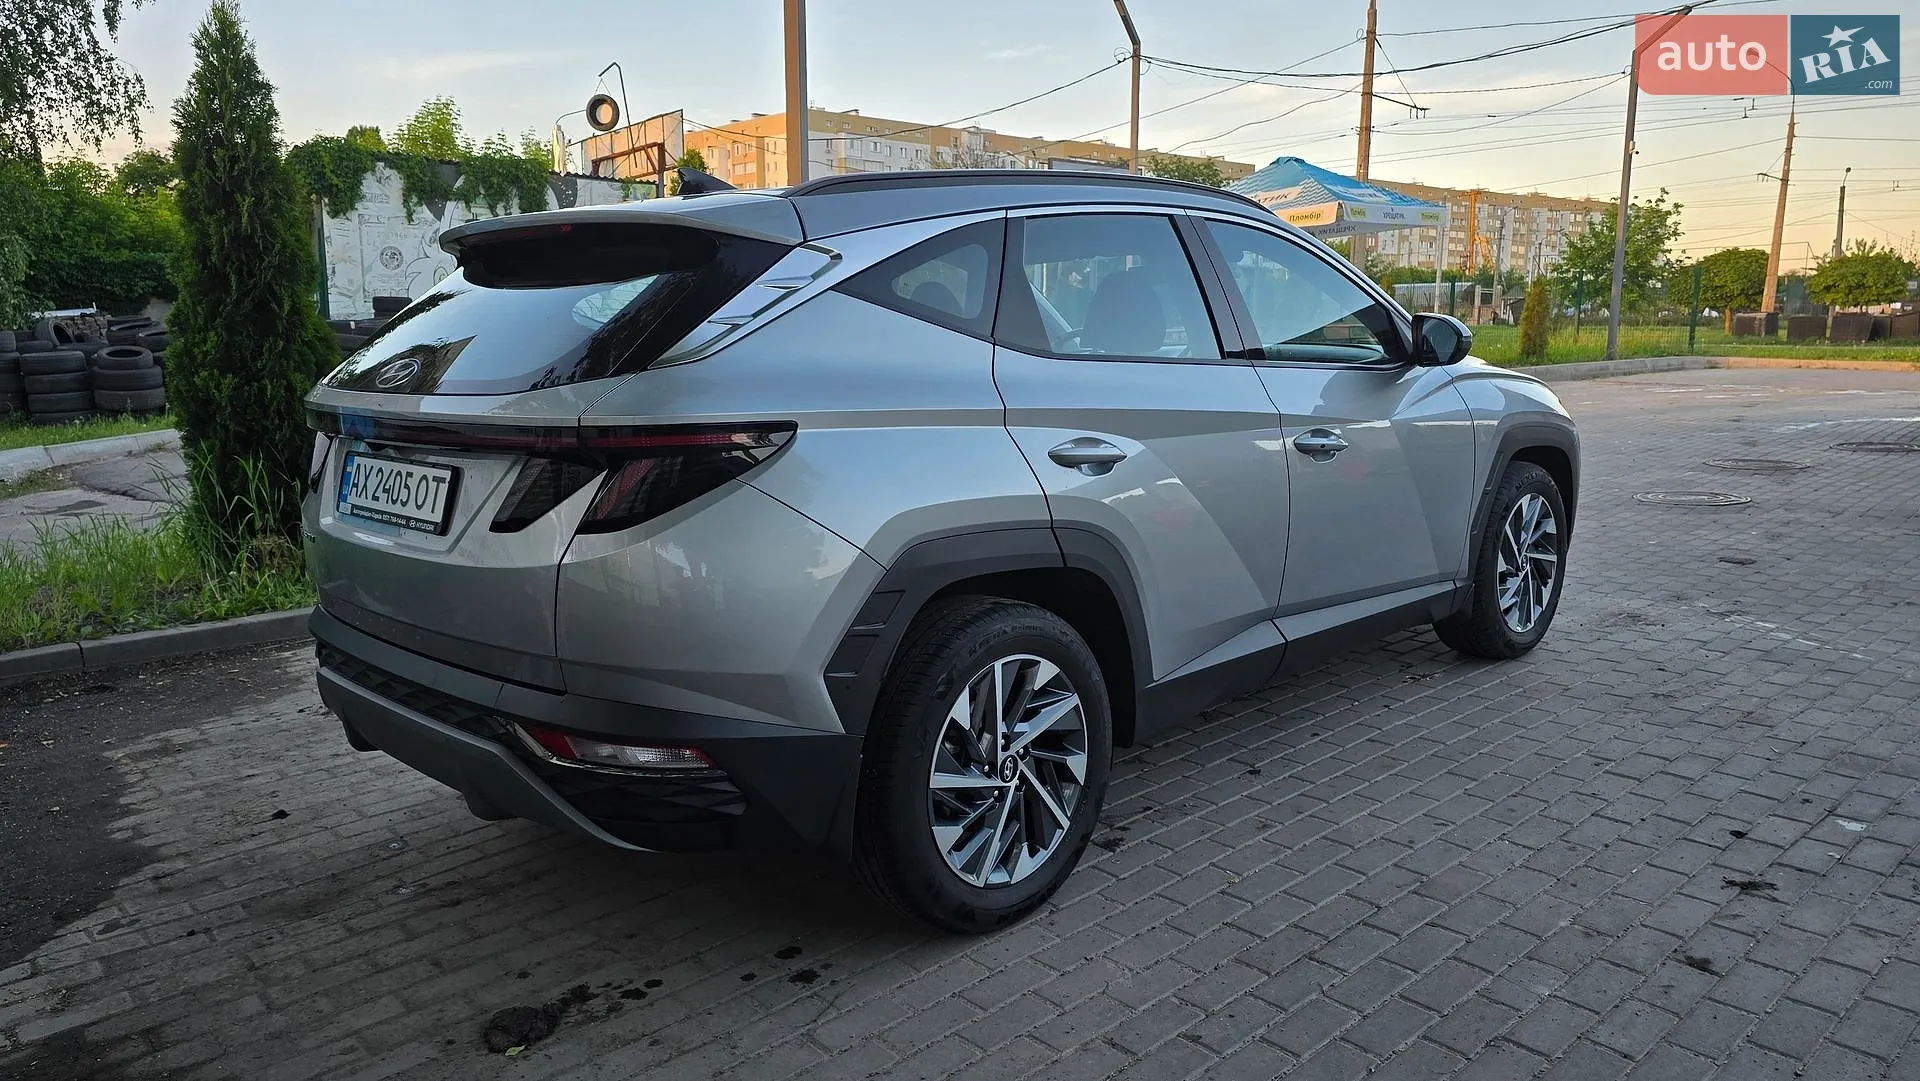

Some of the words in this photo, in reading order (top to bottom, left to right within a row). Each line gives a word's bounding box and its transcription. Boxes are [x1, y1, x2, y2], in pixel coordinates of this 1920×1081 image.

[1289, 212, 1321, 222] Пломбір
[349, 463, 374, 500] AX
[371, 467, 414, 508] 2405
[415, 474, 447, 514] OT
